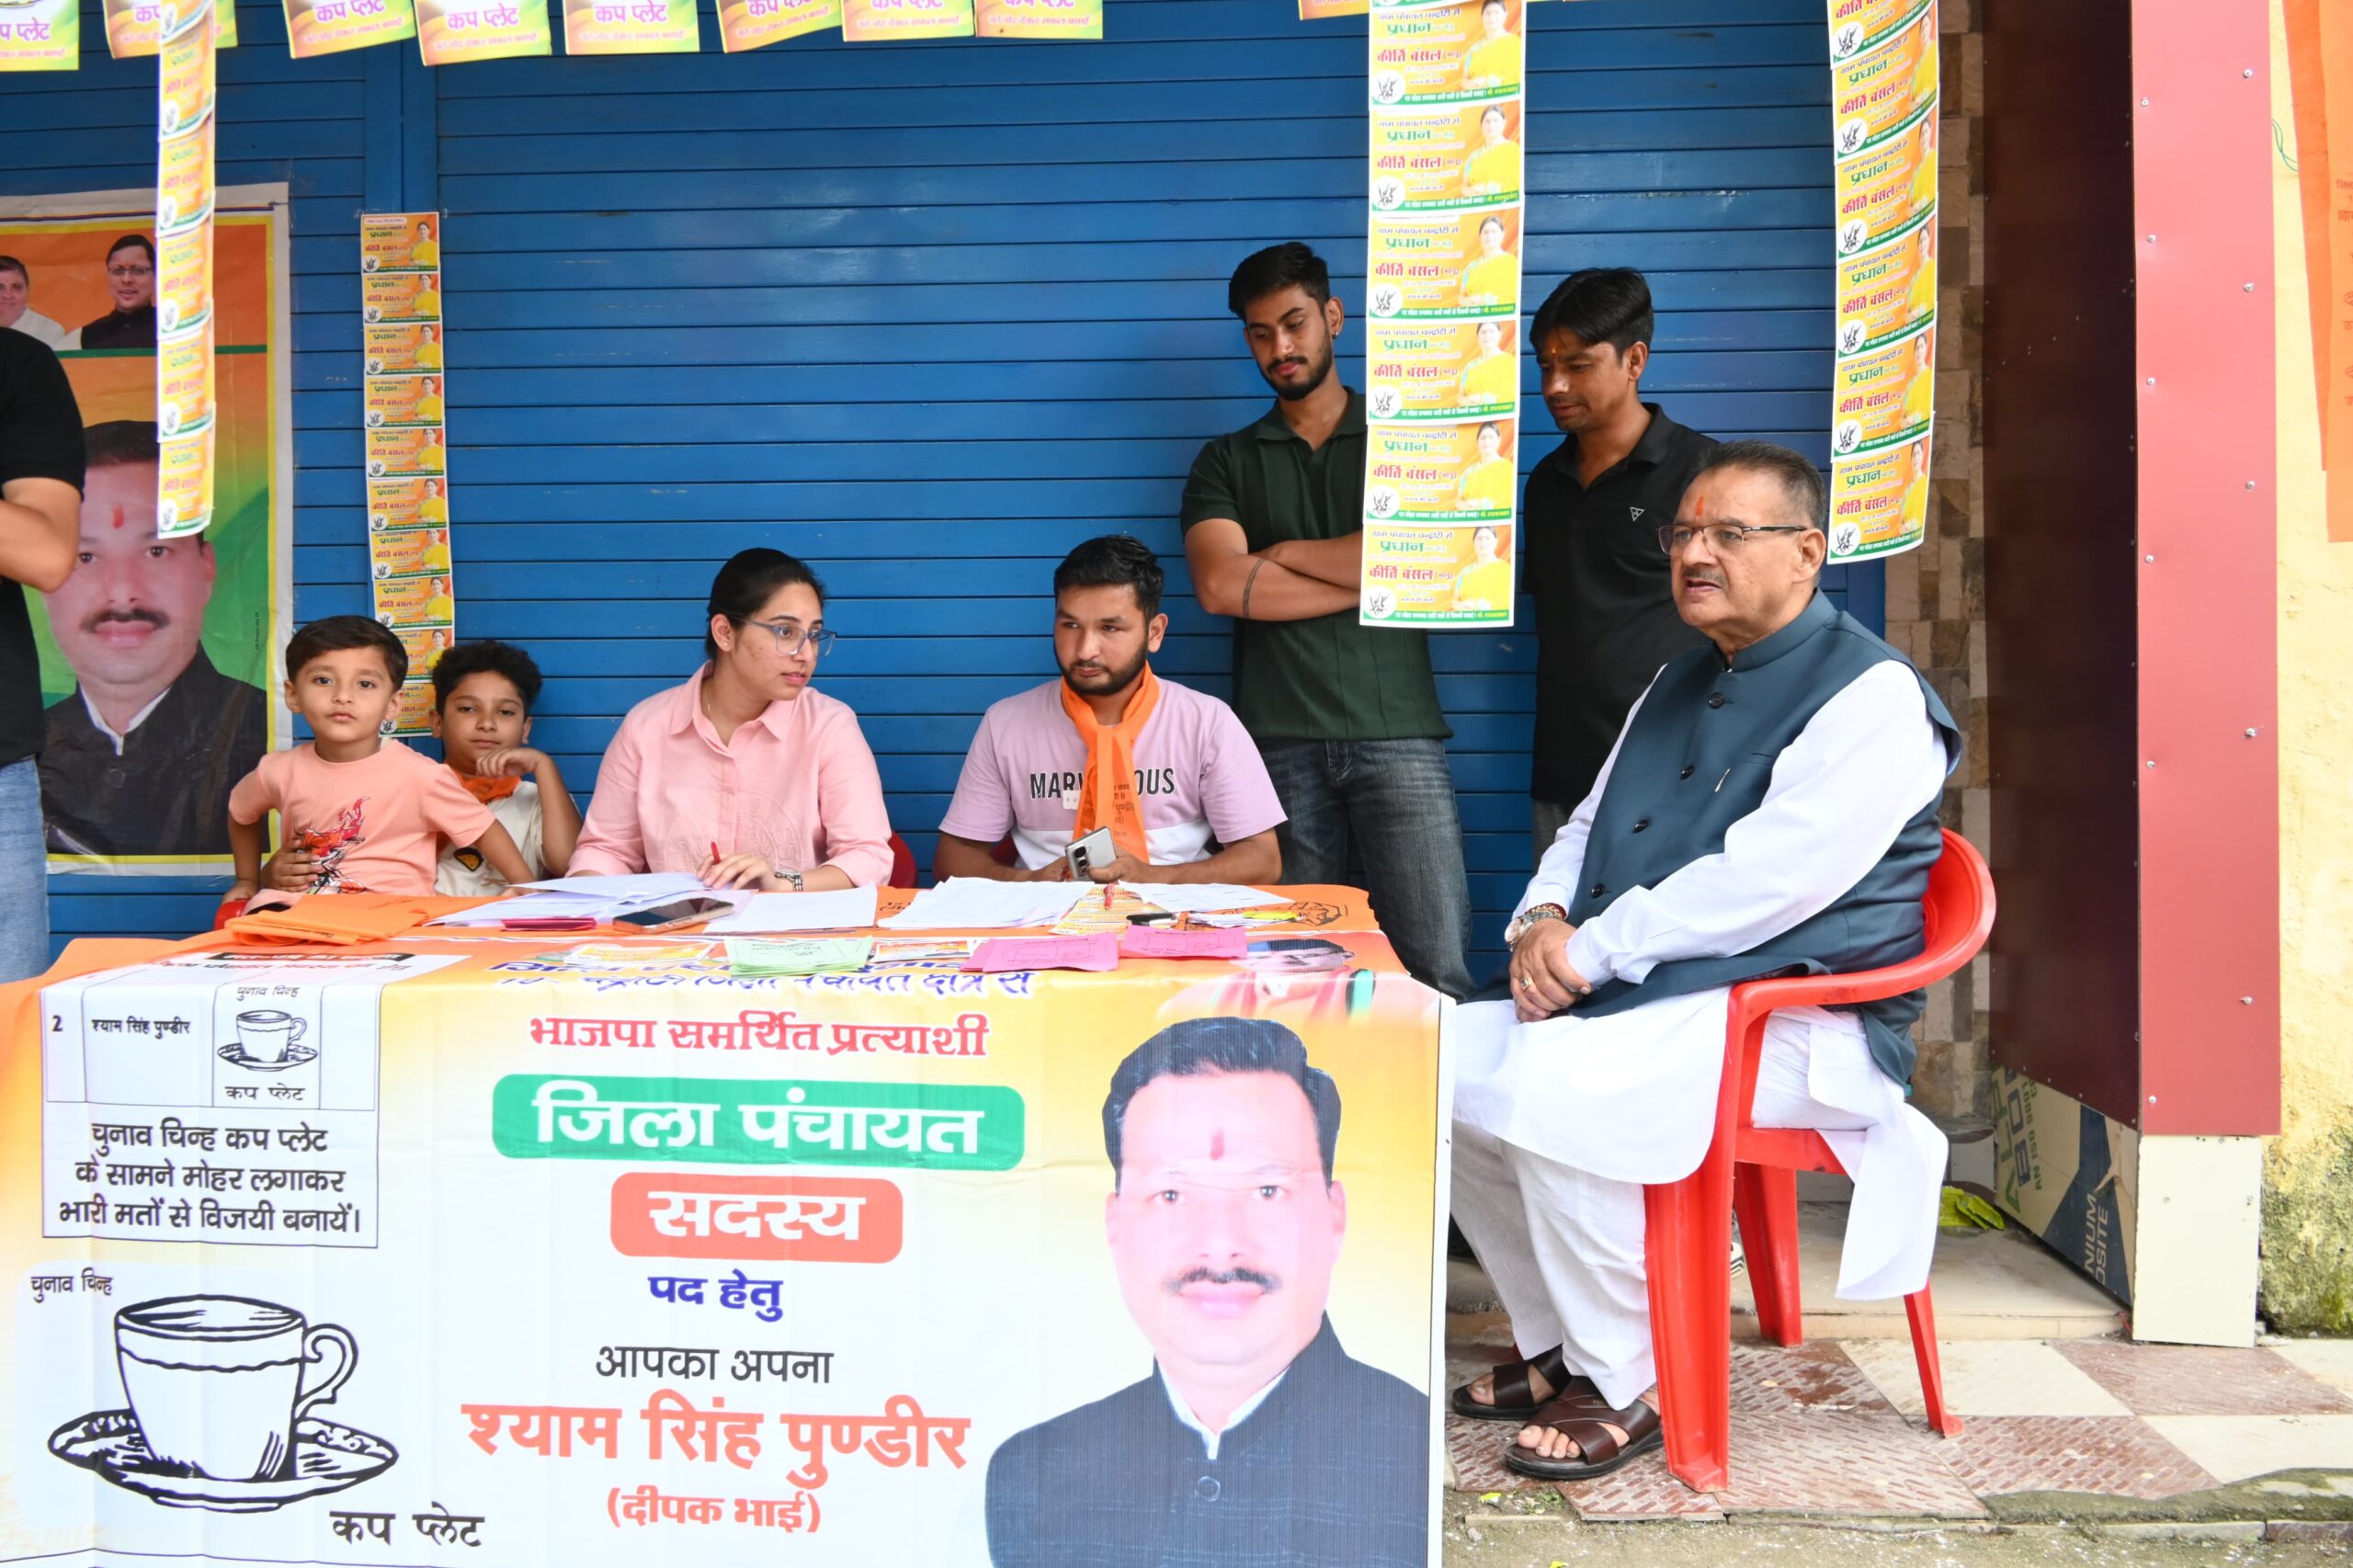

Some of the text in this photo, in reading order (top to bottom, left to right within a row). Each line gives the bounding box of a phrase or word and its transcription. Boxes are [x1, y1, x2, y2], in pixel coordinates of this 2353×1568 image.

[447, 11, 478, 29] कप
[595, 4, 626, 23] कप
[1387, 23, 1431, 36] प्रधान
[1377, 47, 1441, 62] कीर्ति बंसल
[1849, 60, 1887, 85] प्रधान
[1841, 84, 1895, 115] कीर्ति बंसल
[1387, 131, 1431, 142] प्रधान
[1377, 154, 1441, 169] कीर्ति बंसल
[1851, 161, 1887, 186] प्रधान
[1843, 188, 1894, 214] कीर्ति बंसल
[1385, 237, 1429, 250] प्रधान
[1375, 262, 1439, 277] कीर्ति बंसल
[1383, 339, 1427, 352] प्रधान
[1374, 364, 1438, 378] कीर्ति बंसल
[1384, 440, 1427, 452] प्रधान
[1373, 464, 1437, 480] कीर्ति बंसल
[1847, 470, 1881, 488] प्रधान
[1837, 496, 1887, 515] कीर्ति बंसल
[1381, 540, 1424, 552] प्रधान
[1370, 565, 1433, 580] कीर्ति बंसल
[52, 1016, 63, 1032] 2
[92, 1017, 191, 1040] श्याम सिंह पुण्डीर
[529, 1010, 989, 1058] भाजपा समर्थित प्रत्याशी
[225, 1082, 306, 1102] कप प्लेट
[531, 1080, 986, 1154] जिला पंचायत
[91, 1117, 328, 1157] चुनाव चिन्ह कप प्लेट
[74, 1153, 346, 1193] के सामने मोहर लगाकर
[59, 1193, 108, 1225] भारी
[114, 1198, 165, 1227] मतों
[169, 1198, 192, 1228] से
[200, 1198, 275, 1232] विजयी
[646, 1191, 867, 1241] सदस्य
[30, 1267, 113, 1303] चुनाव चिन्ह
[648, 1268, 784, 1324] पद हेतु
[596, 1346, 835, 1384] आपका अपना
[460, 1389, 972, 1490] श्याम सिंह पुण्डीर
[607, 1485, 822, 1534] (दीपक भाई)
[329, 1501, 484, 1548] कप प्लेट
